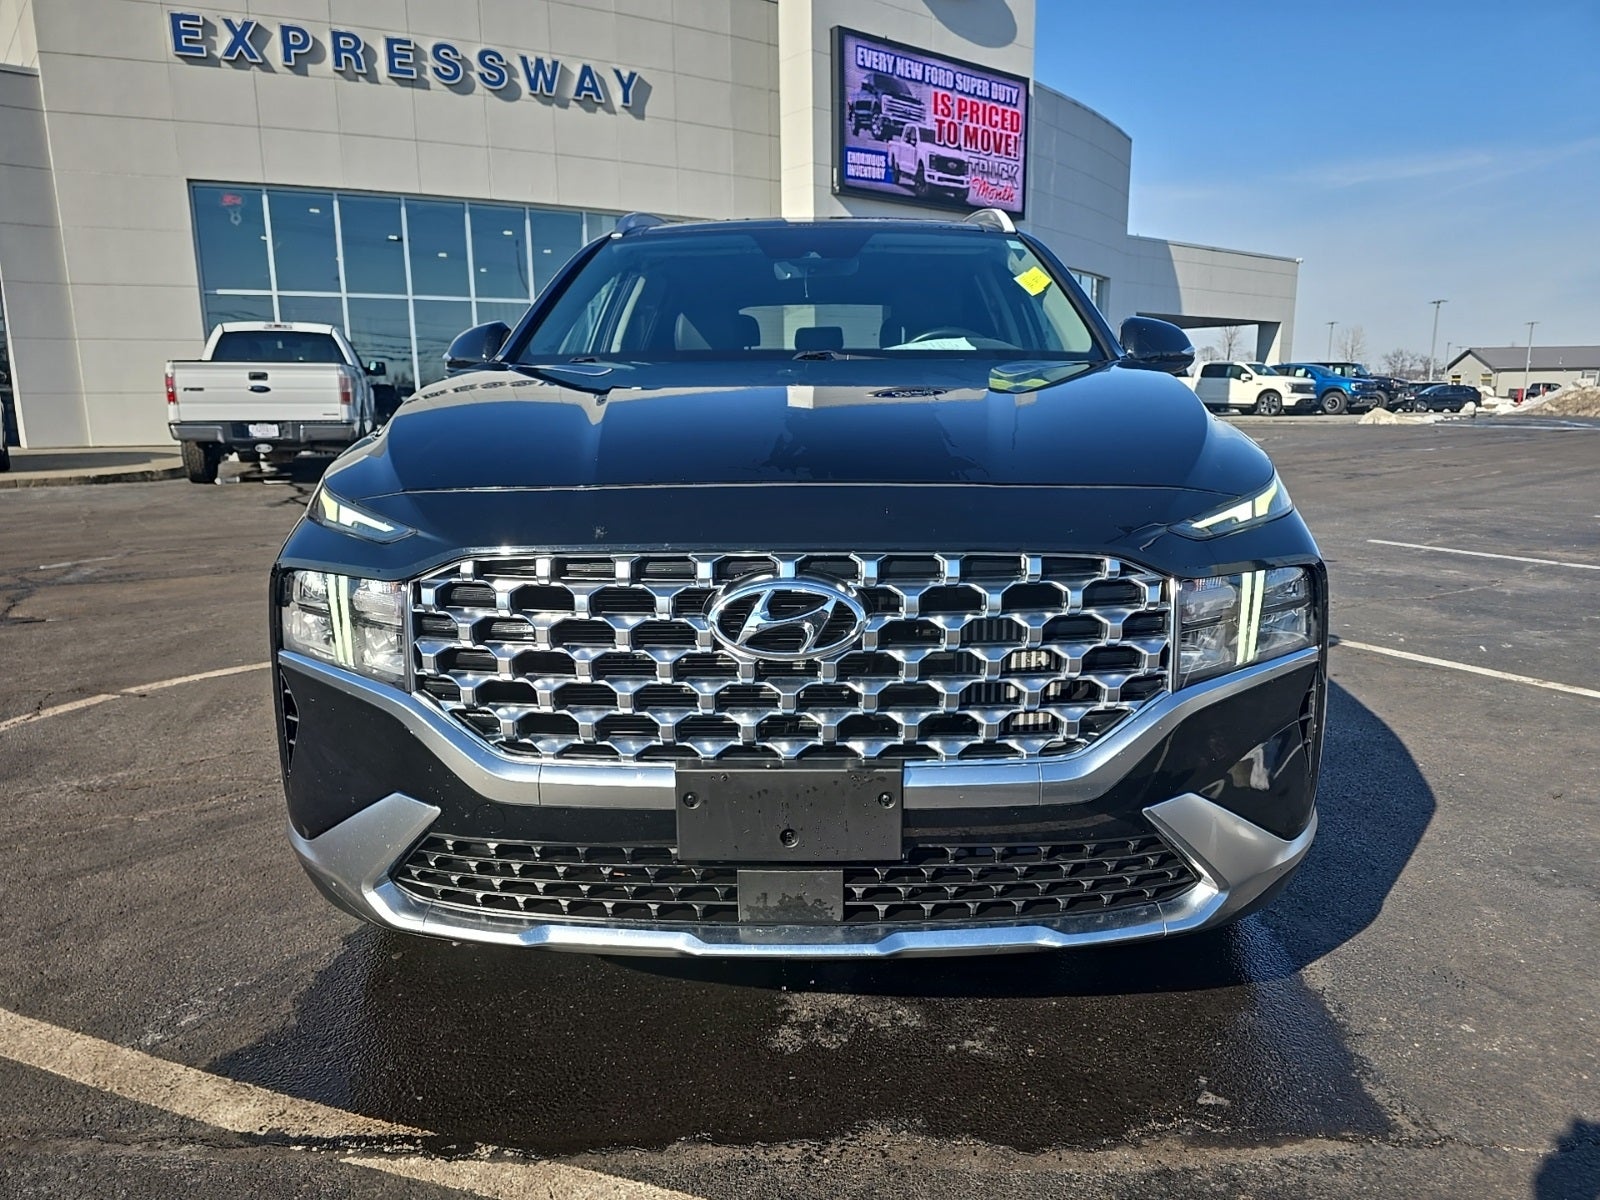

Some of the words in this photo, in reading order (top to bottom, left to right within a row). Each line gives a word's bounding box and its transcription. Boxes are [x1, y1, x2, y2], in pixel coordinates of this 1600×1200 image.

[168, 11, 640, 108] EXPRESSWAY
[856, 46, 894, 74] EVERY
[896, 56, 924, 81] NEW
[924, 65, 954, 89] FORD
[955, 74, 990, 97] SUPER
[991, 80, 1018, 105] DUTY
[933, 91, 951, 118] IS
[956, 97, 1021, 134] PRICED
[934, 118, 959, 145] TO
[963, 125, 1018, 158] MOVE!
[968, 156, 1019, 189] TRUCK
[971, 178, 1014, 204] Month
